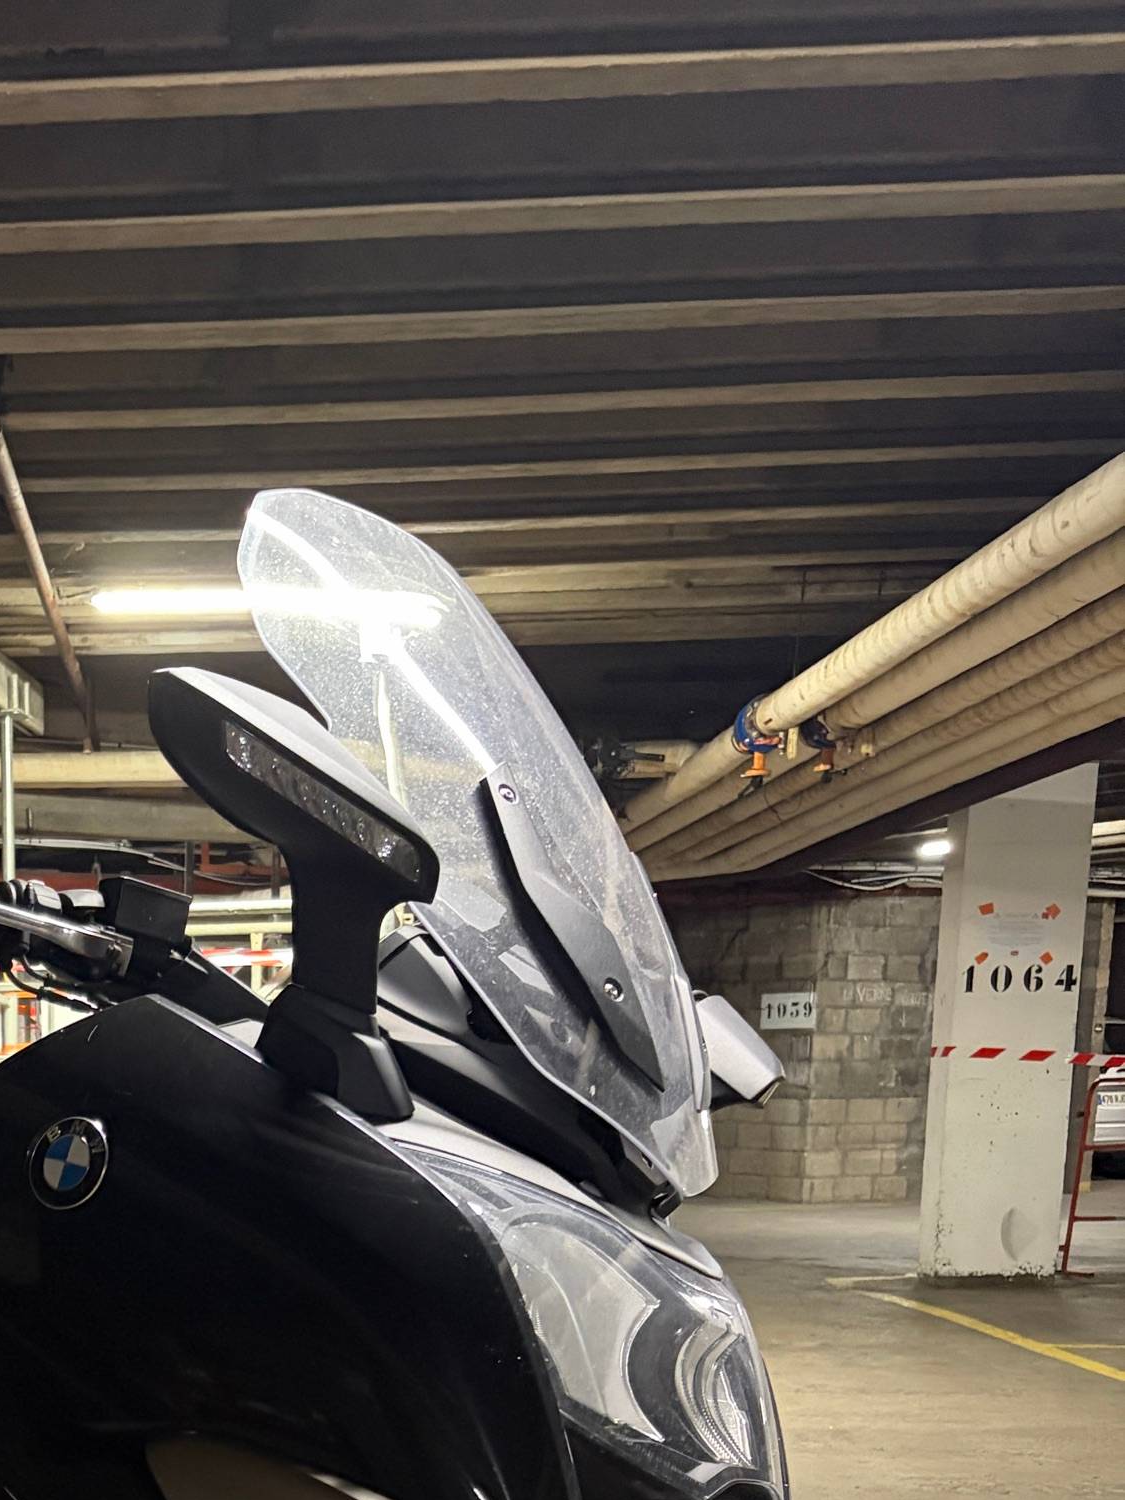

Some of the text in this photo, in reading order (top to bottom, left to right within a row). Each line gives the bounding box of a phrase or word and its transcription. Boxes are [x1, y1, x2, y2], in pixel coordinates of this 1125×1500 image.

[962, 964, 1077, 993] 1064
[765, 1001, 813, 1019] 1059
[45, 1118, 105, 1154] BMW
